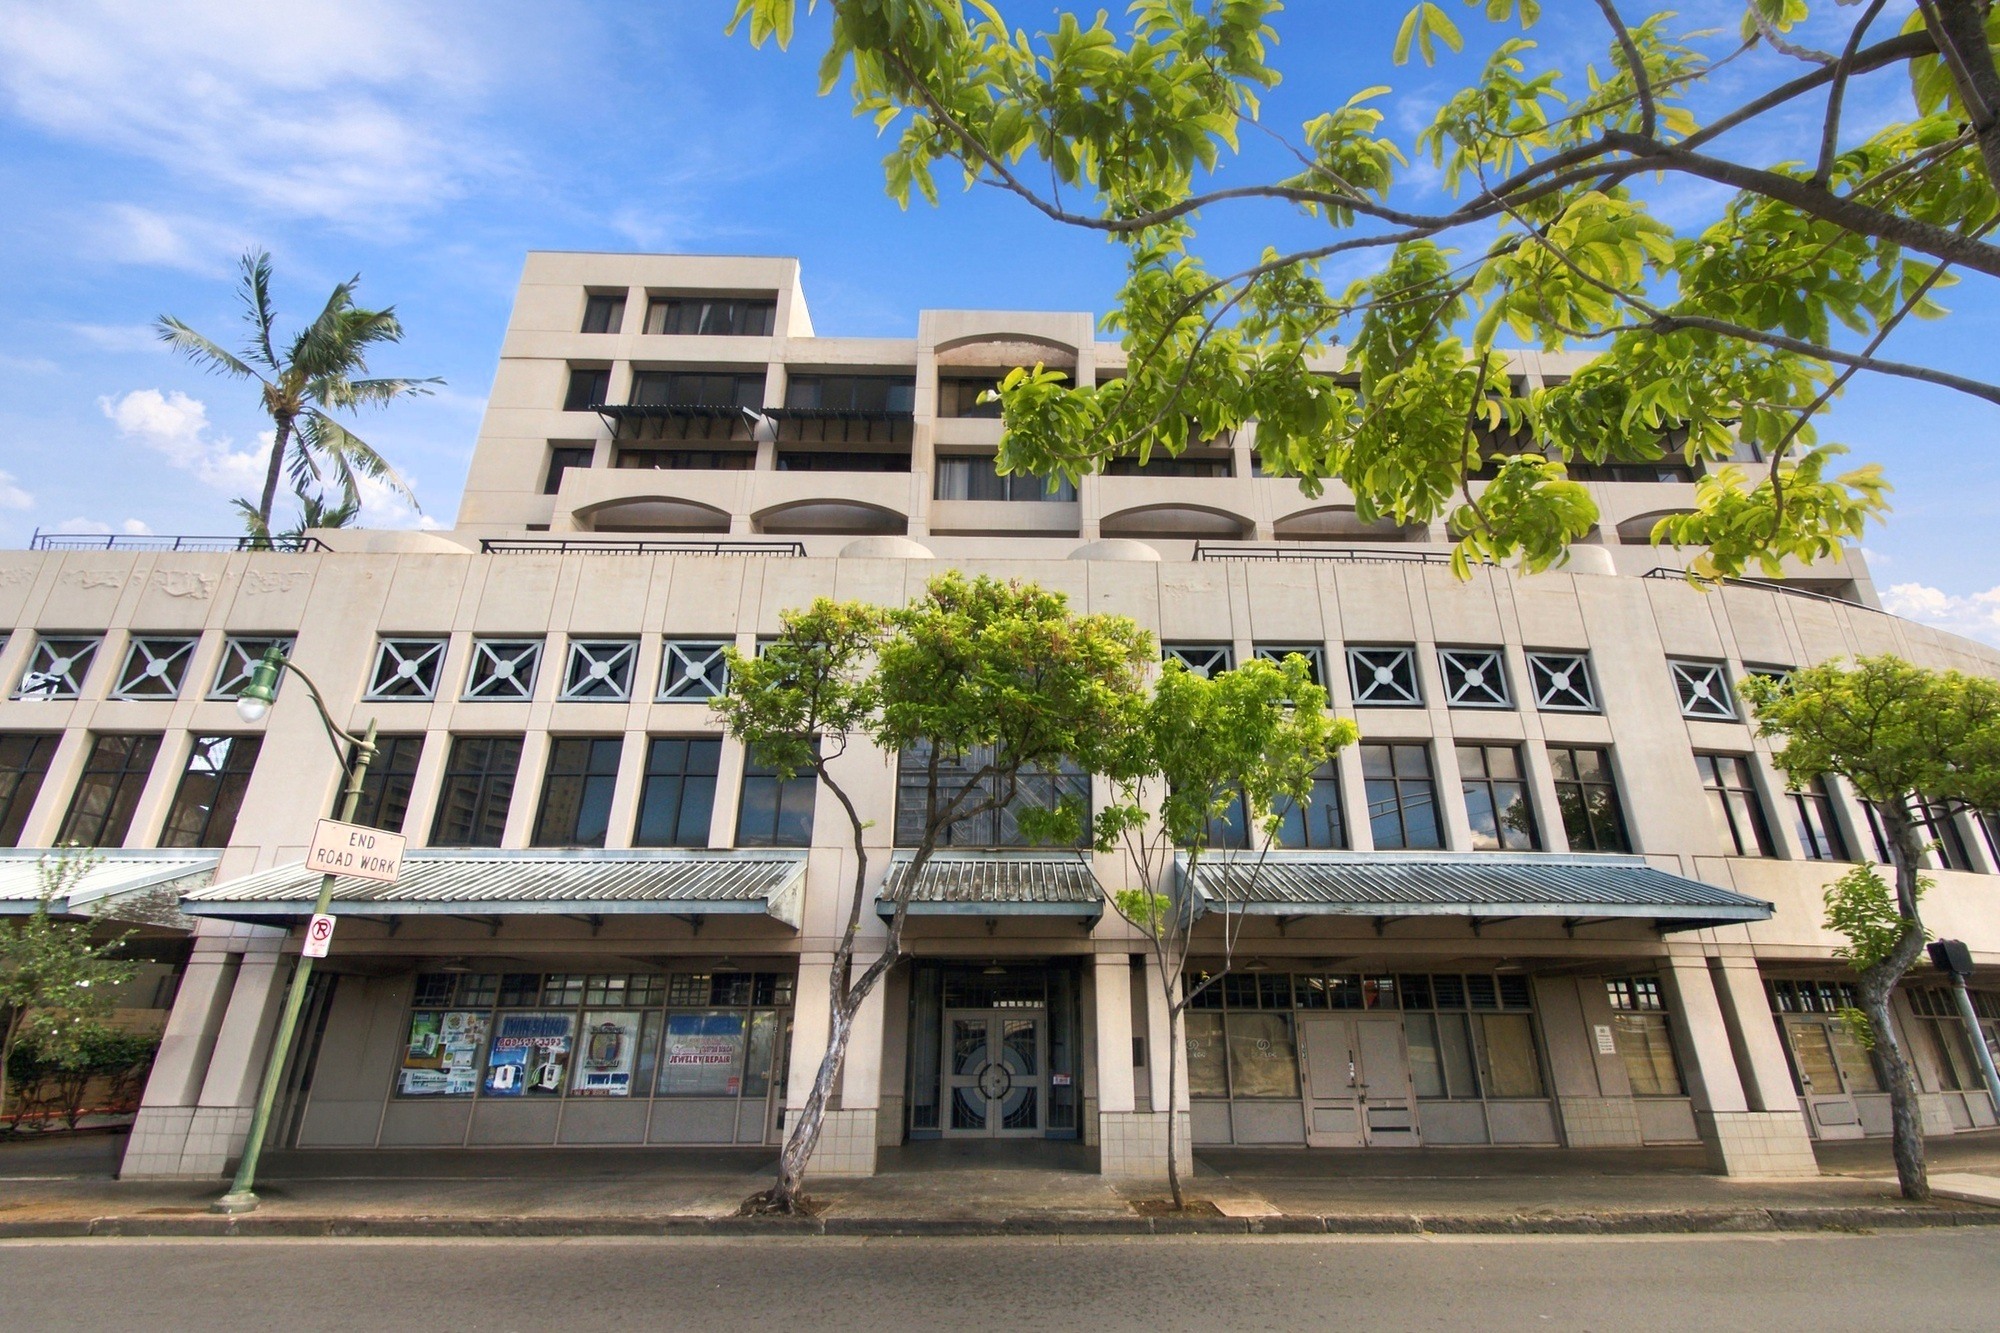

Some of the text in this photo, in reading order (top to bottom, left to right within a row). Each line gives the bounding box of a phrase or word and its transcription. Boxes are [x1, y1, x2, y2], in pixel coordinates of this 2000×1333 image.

[349, 832, 375, 849] END
[317, 848, 396, 874] ROAD WORK
[670, 1055, 731, 1064] JEWELRY REPAIR
